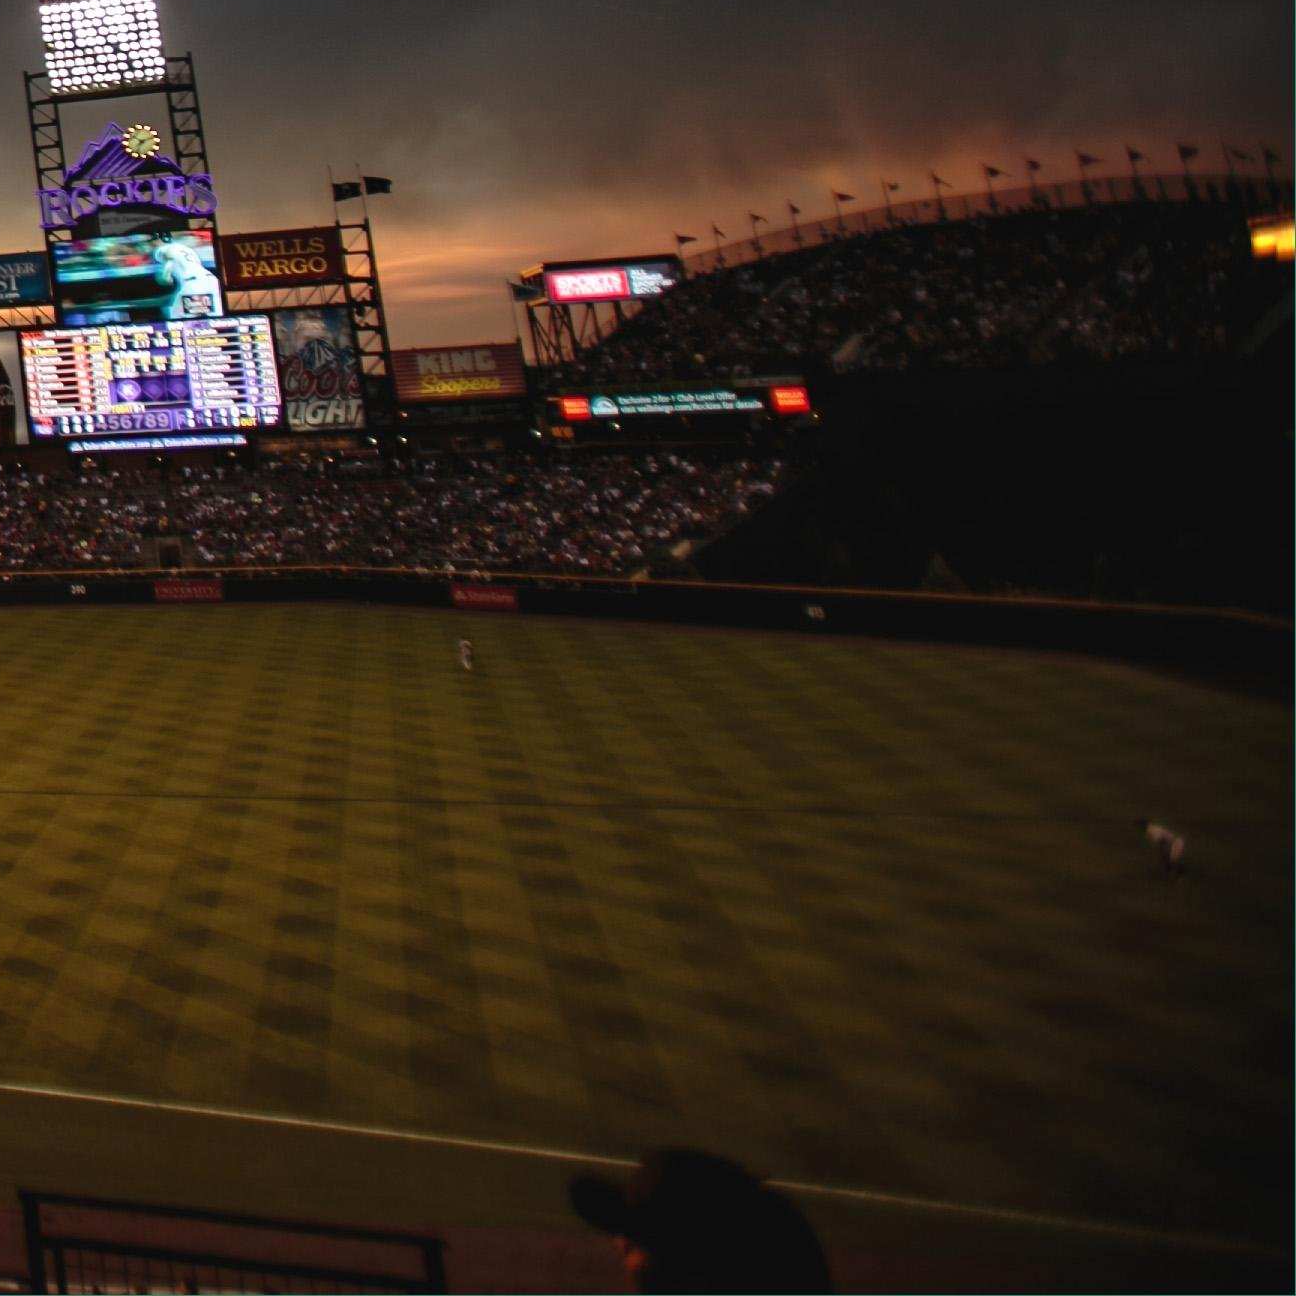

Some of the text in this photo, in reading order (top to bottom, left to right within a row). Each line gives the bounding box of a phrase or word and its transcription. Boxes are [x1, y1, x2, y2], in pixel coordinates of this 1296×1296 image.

[36, 174, 218, 229] ROCKIES
[234, 237, 326, 258] WELLS
[238, 256, 328, 278] FARGO
[417, 349, 496, 376] KING
[420, 373, 502, 396] Soopers
[285, 398, 365, 432] LIGHT
